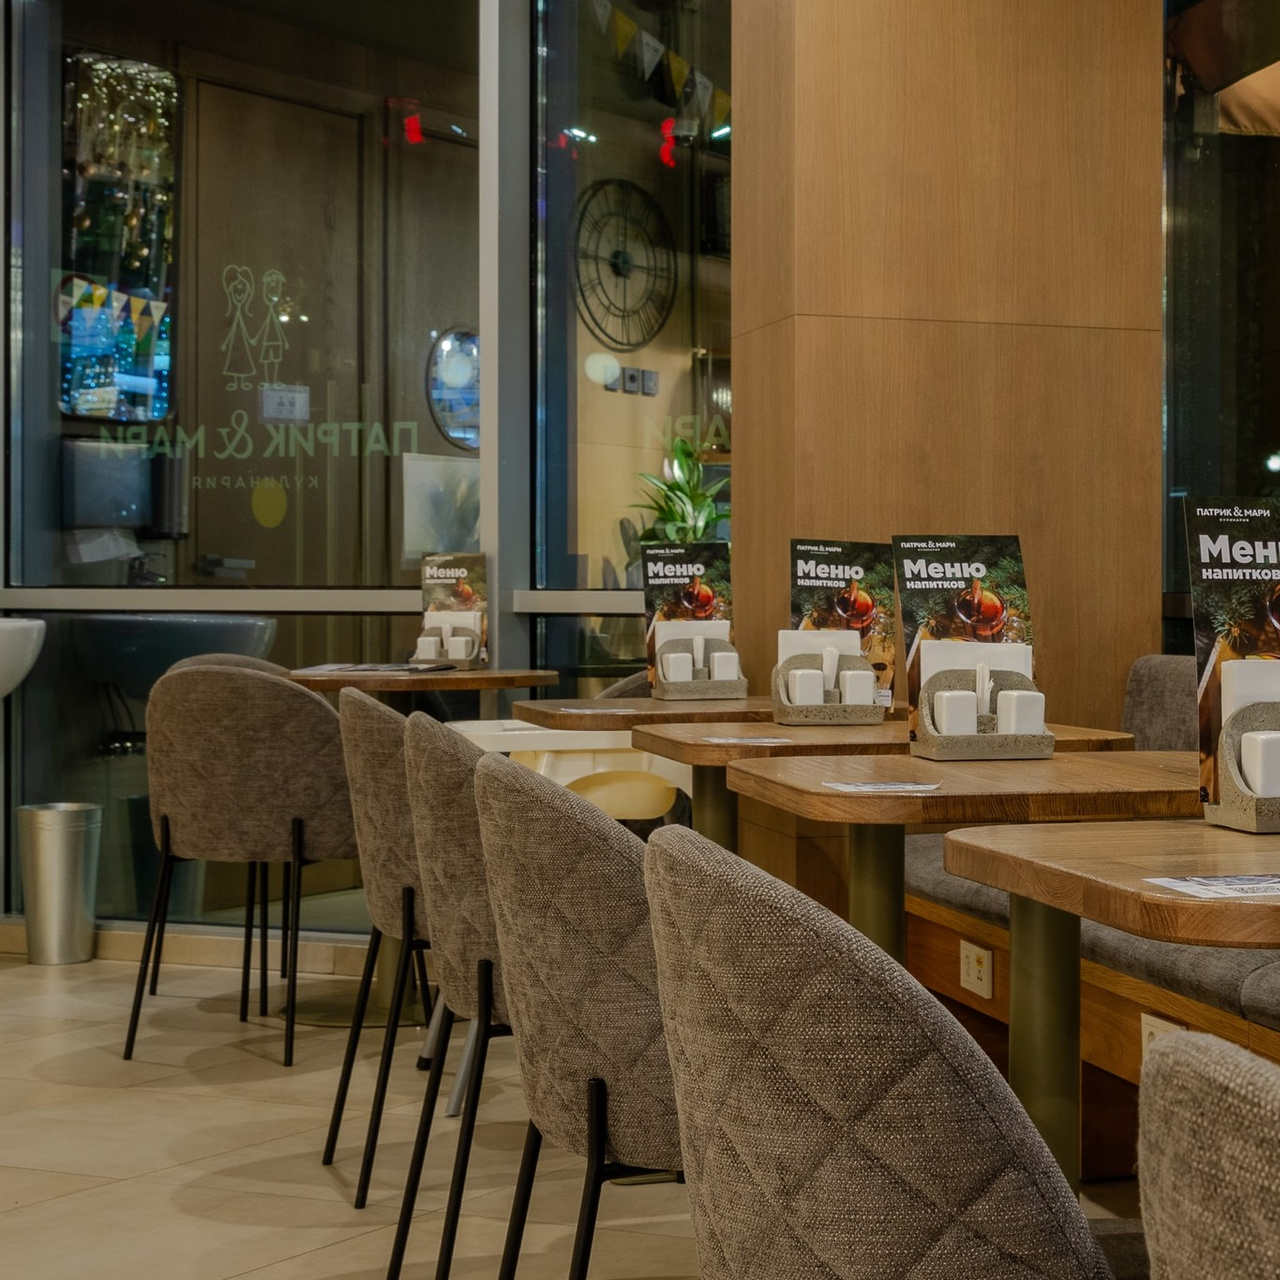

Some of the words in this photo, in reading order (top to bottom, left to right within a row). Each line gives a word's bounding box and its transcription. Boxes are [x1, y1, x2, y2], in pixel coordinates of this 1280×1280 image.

[1196, 508, 1232, 517] ПАТРИК
[1233, 506, 1244, 517] &
[1244, 509, 1271, 517] МАРИ
[425, 566, 468, 578] Меню
[647, 562, 705, 577] Меню
[797, 559, 864, 580] Меню
[903, 559, 987, 578] Меню
[648, 577, 690, 585] напитков
[797, 578, 846, 588] напитков
[906, 580, 966, 589] напитков
